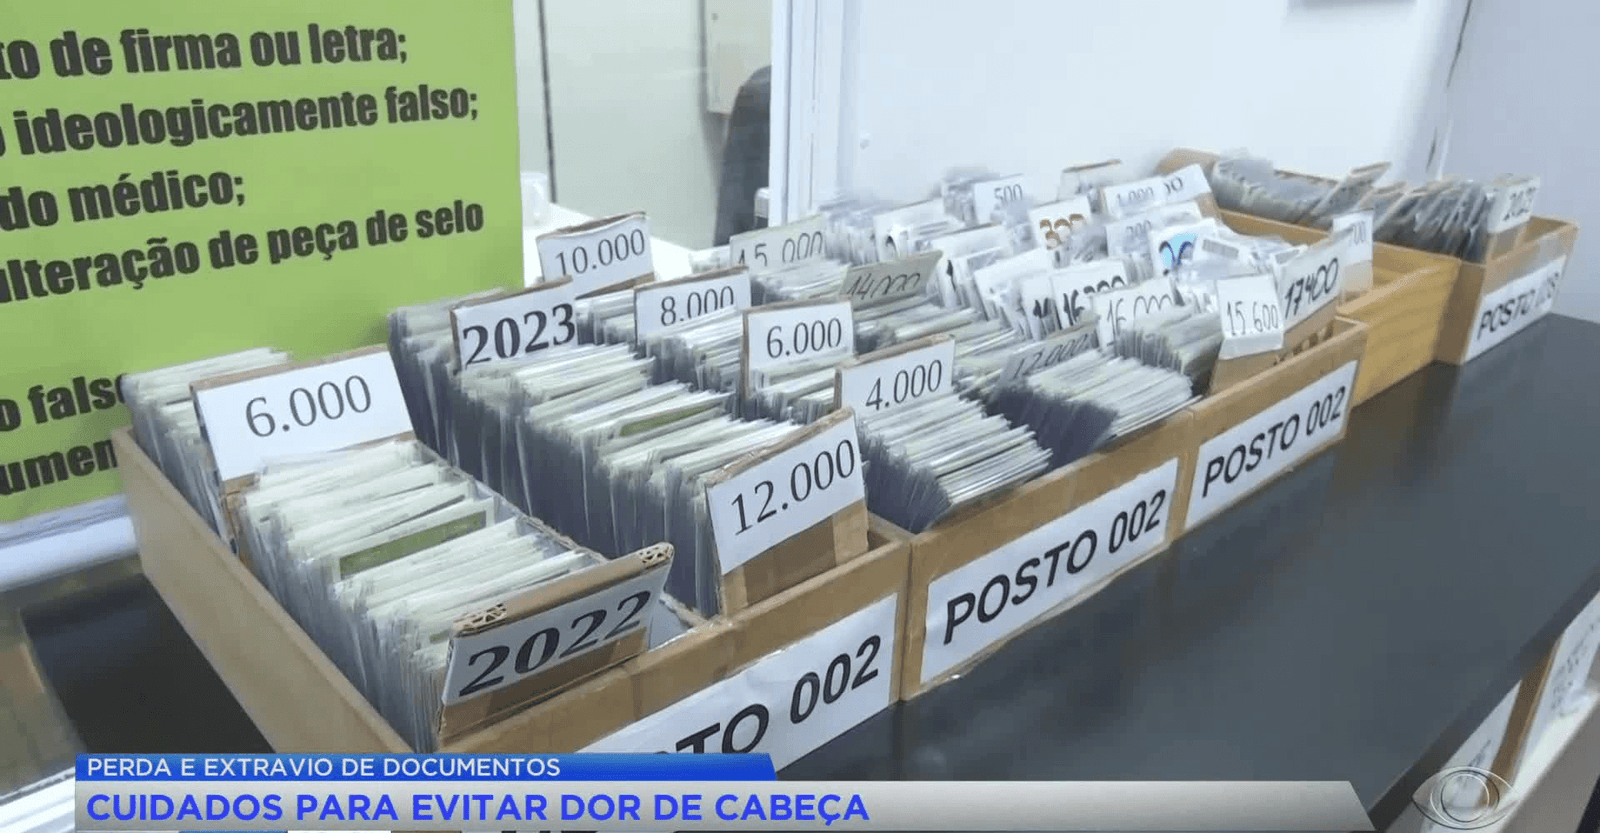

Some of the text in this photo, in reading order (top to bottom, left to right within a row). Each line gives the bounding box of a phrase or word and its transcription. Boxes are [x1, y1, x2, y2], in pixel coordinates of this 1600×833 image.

[50, 31, 113, 77] de
[120, 29, 242, 73] firma
[251, 32, 301, 67] ou
[309, 24, 407, 64] letra;
[13, 92, 378, 155] ideologicamente
[385, 85, 477, 123] falso;
[68, 170, 244, 222] médico;
[209, 230, 259, 269] de
[267, 220, 358, 265] peça
[367, 210, 408, 246] de
[416, 200, 483, 238] selo
[555, 228, 646, 276] 10.000
[463, 303, 576, 366] 2023
[661, 286, 734, 326] 8.000
[766, 318, 842, 359] 6.000
[245, 374, 373, 438] 6.000
[865, 359, 943, 411] 4.000
[1202, 386, 1346, 499] POSTO 002
[731, 439, 855, 536] 12.000
[943, 489, 1167, 646] POSTO 002
[458, 590, 652, 697] 2022
[789, 634, 882, 724] 002
